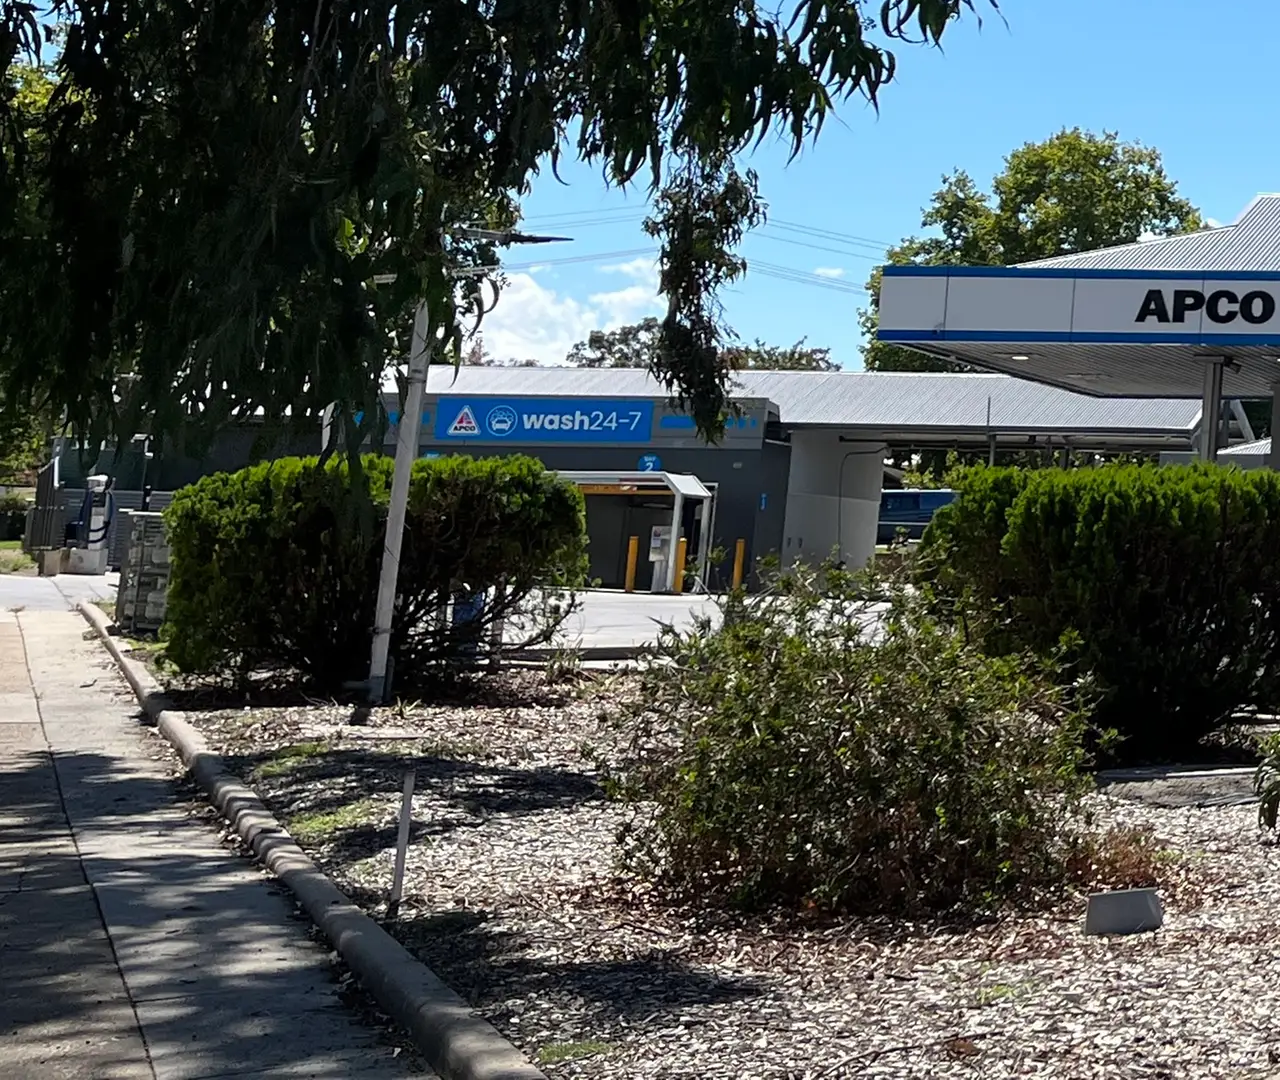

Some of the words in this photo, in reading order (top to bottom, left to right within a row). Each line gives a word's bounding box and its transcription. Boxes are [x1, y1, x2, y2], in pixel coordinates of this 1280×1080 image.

[1134, 289, 1276, 324] APCO
[522, 410, 643, 431] wash24-7
[645, 463, 654, 472] 2
